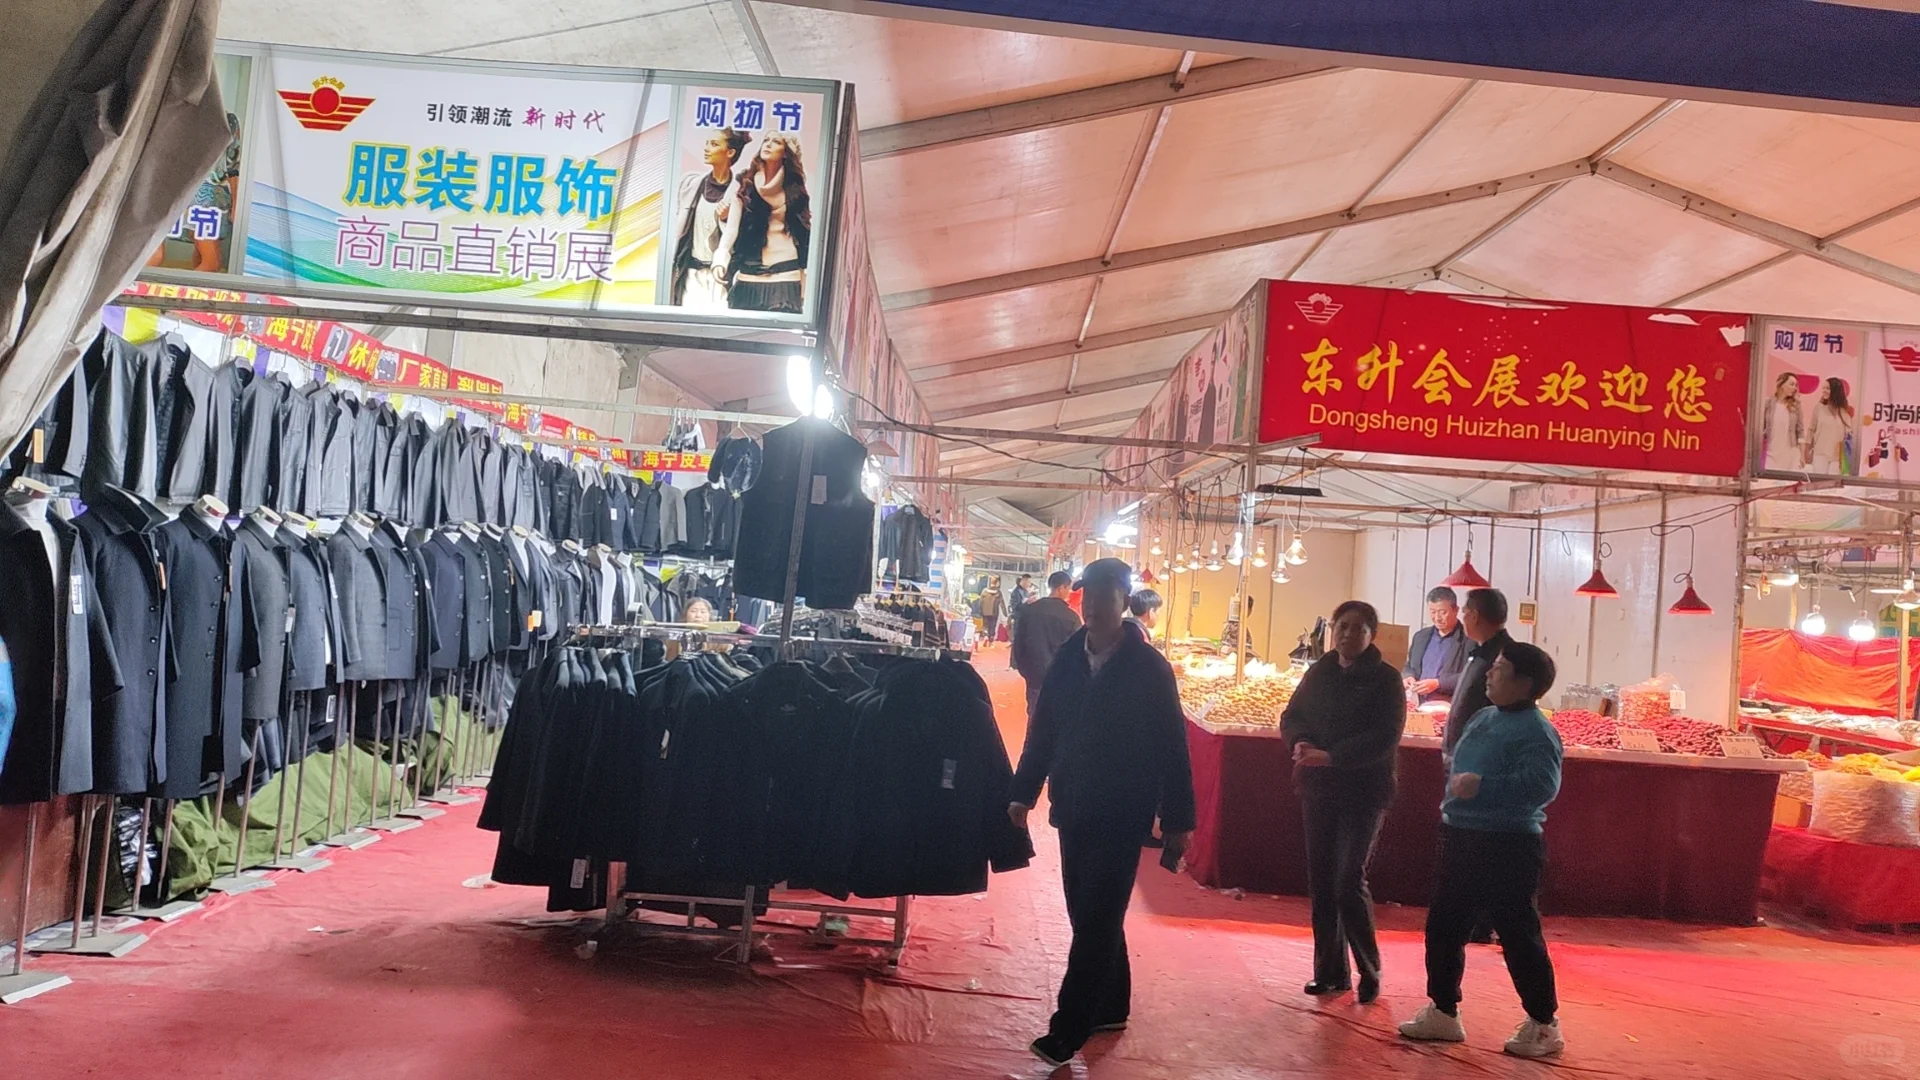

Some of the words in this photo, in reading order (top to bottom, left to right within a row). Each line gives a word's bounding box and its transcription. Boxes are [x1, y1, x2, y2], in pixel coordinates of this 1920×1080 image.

[427, 103, 513, 127] 引领潮流
[522, 105, 606, 133] 新时代
[696, 97, 801, 131] 购物节
[345, 143, 618, 222] 服装服饰
[171, 207, 219, 238] 节
[336, 214, 616, 282] 商品直销展
[1774, 329, 1843, 353] 购物节
[1301, 338, 1713, 423] 东升会展欢迎您
[1310, 403, 1439, 438] Dongsheng
[1446, 414, 1539, 440] Huizhan
[1547, 420, 1655, 452] Huanying
[1663, 428, 1700, 450] Nin
[1873, 403, 1920, 424] 时尚
